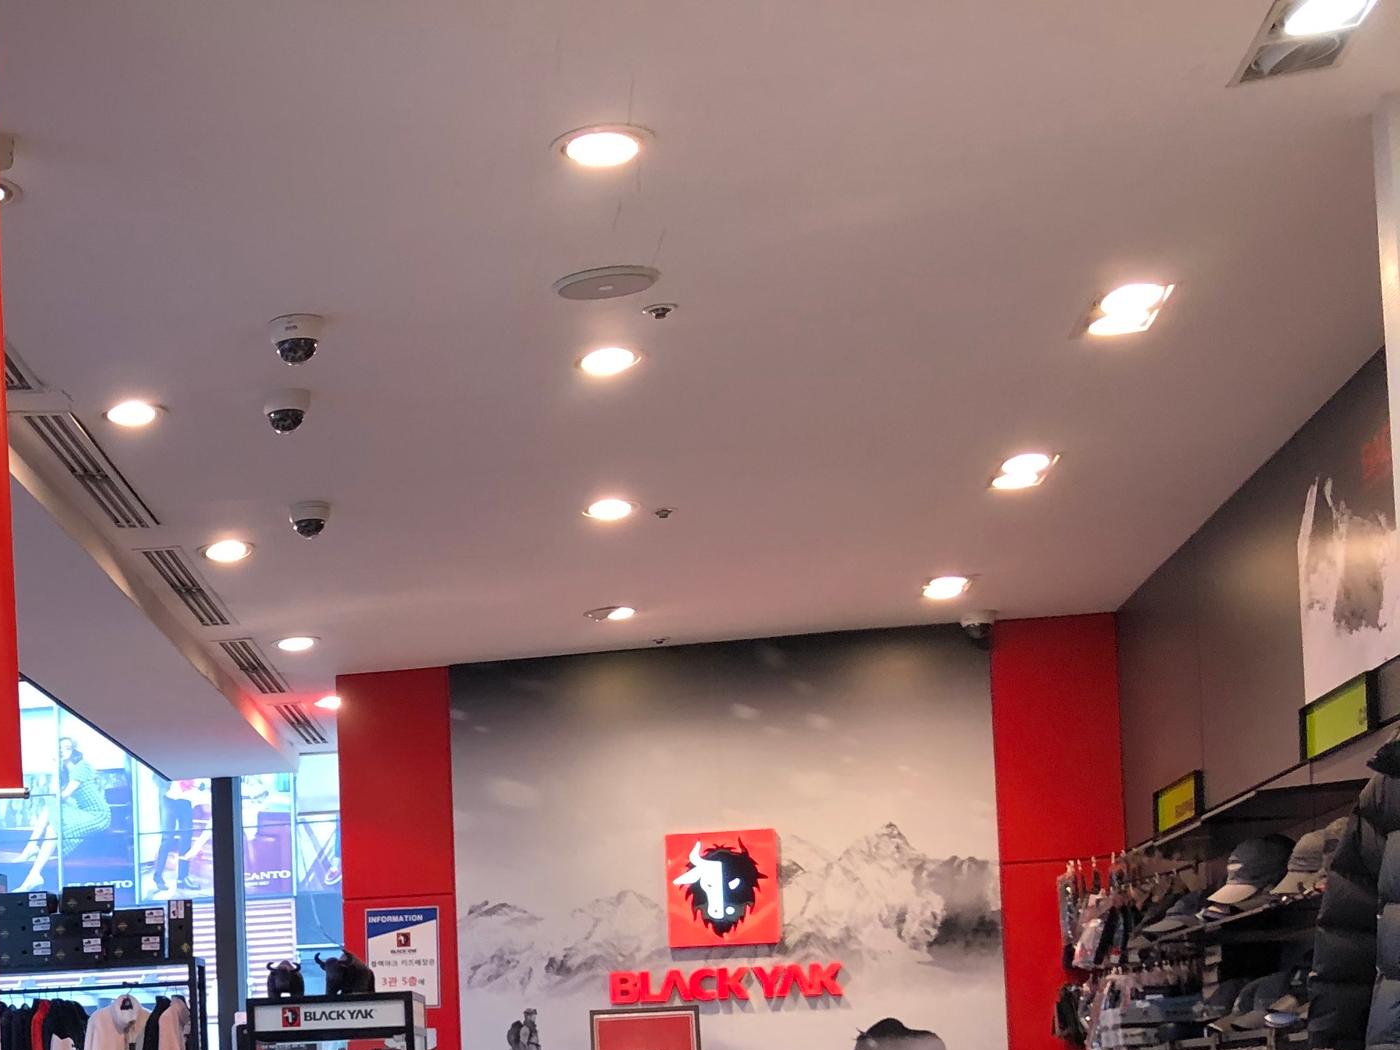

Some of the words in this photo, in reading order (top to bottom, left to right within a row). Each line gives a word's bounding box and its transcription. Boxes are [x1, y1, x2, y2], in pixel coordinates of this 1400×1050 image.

[368, 914, 423, 924] INFORMATION
[610, 967, 750, 1005] BLACK
[751, 961, 843, 998] YAK
[303, 1009, 347, 1022] BLACK
[348, 1008, 375, 1020] YAK
